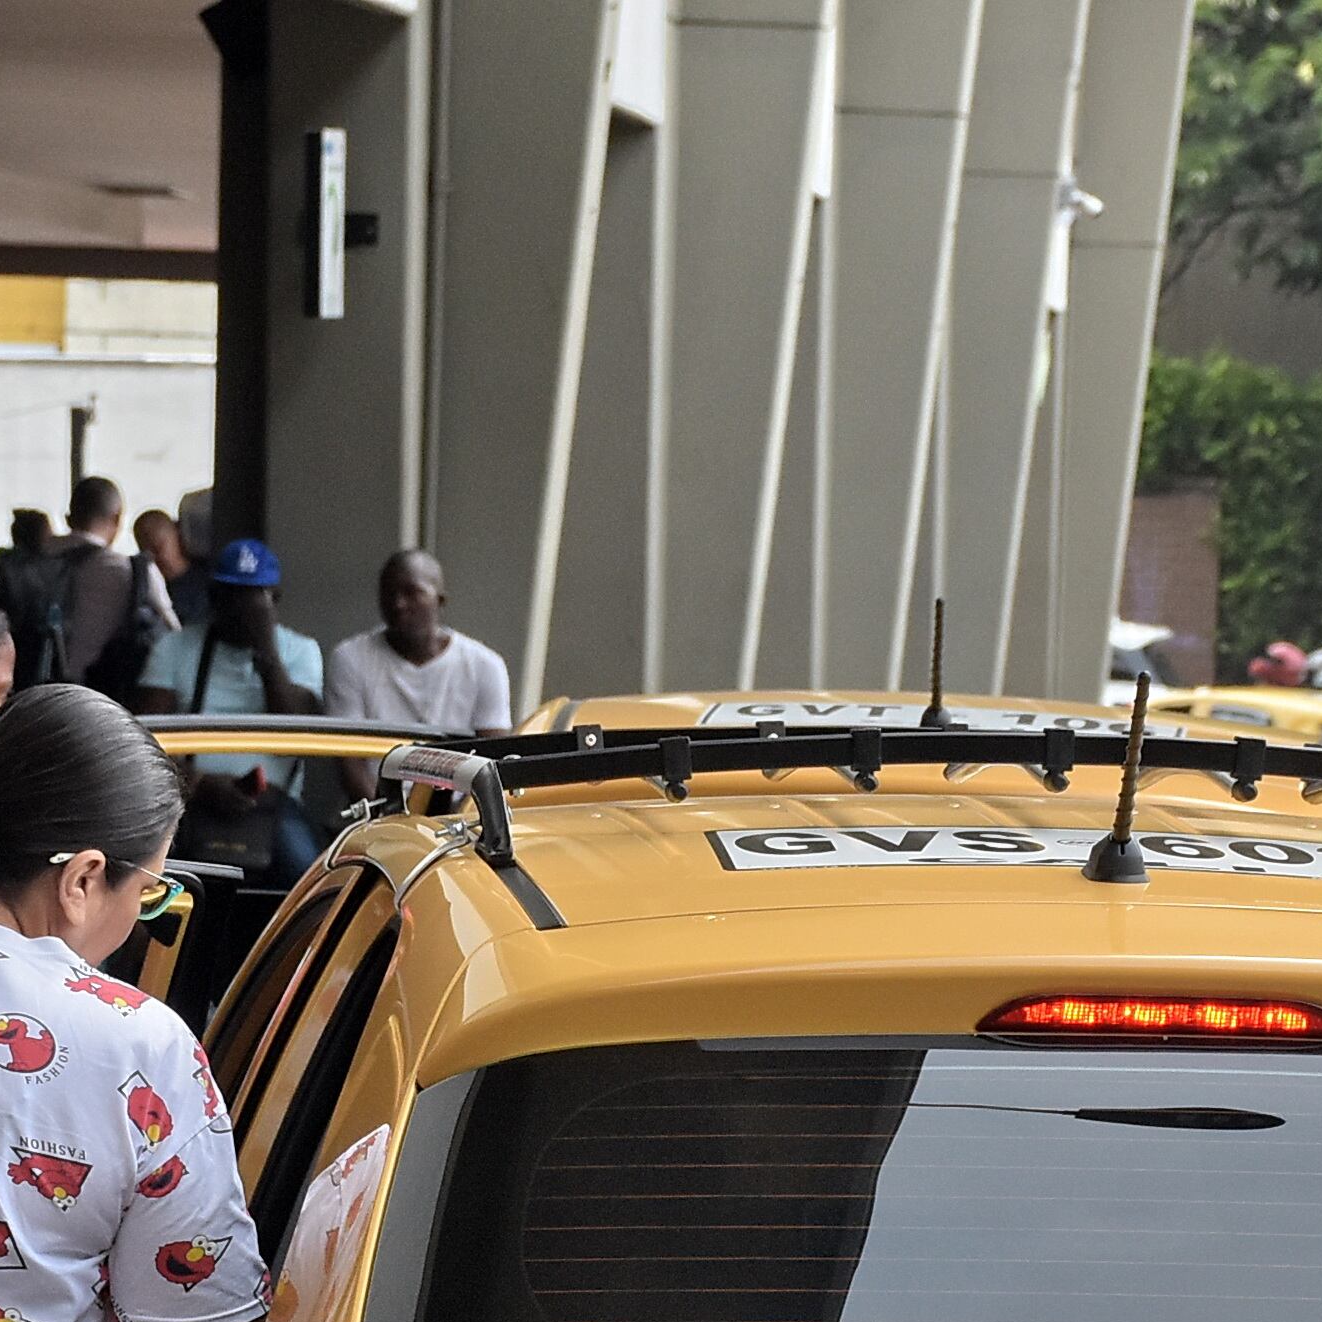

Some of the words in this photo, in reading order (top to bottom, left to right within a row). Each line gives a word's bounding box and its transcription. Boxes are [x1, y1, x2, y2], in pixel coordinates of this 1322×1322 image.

[735, 831, 1045, 854] GVS
[25, 1045, 70, 1085] FASHION
[19, 1135, 87, 1160] FASHION
